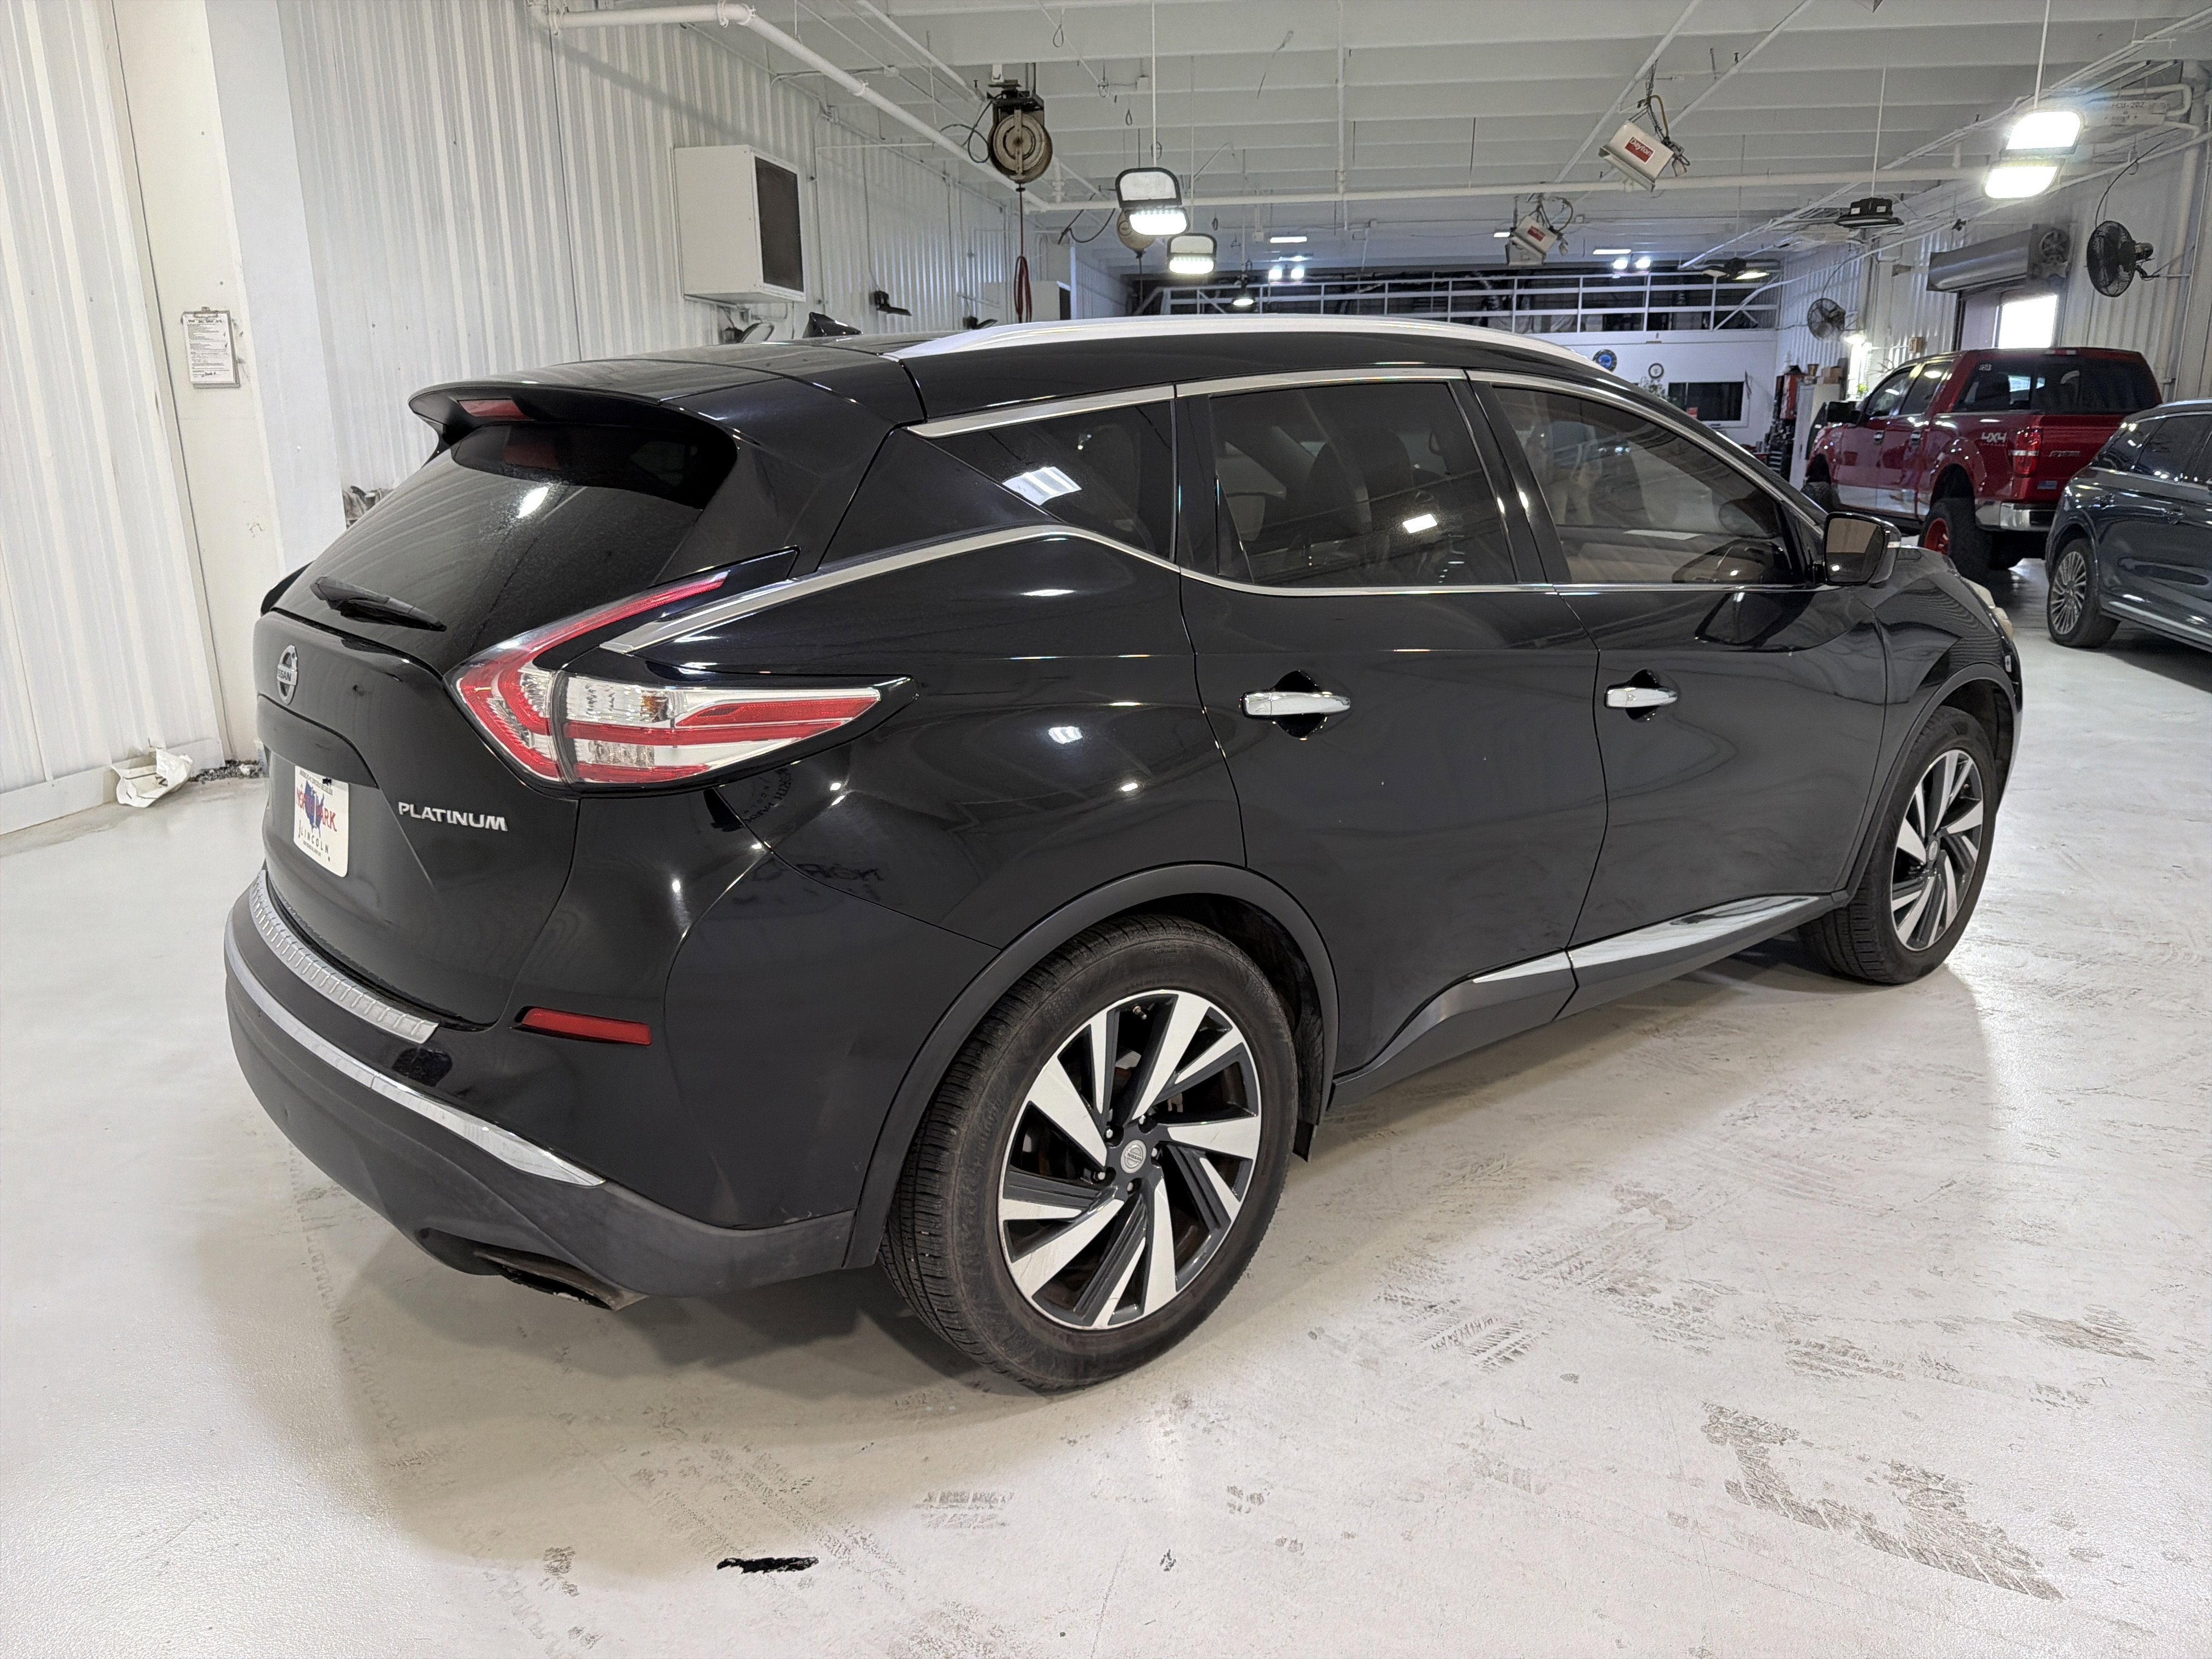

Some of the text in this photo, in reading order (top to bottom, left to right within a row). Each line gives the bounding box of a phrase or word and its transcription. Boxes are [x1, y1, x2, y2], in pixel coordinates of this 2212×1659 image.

[1629, 138, 1652, 156] Dayton
[398, 802, 509, 832] PLATINUM
[301, 826, 329, 854] LINCOLN
